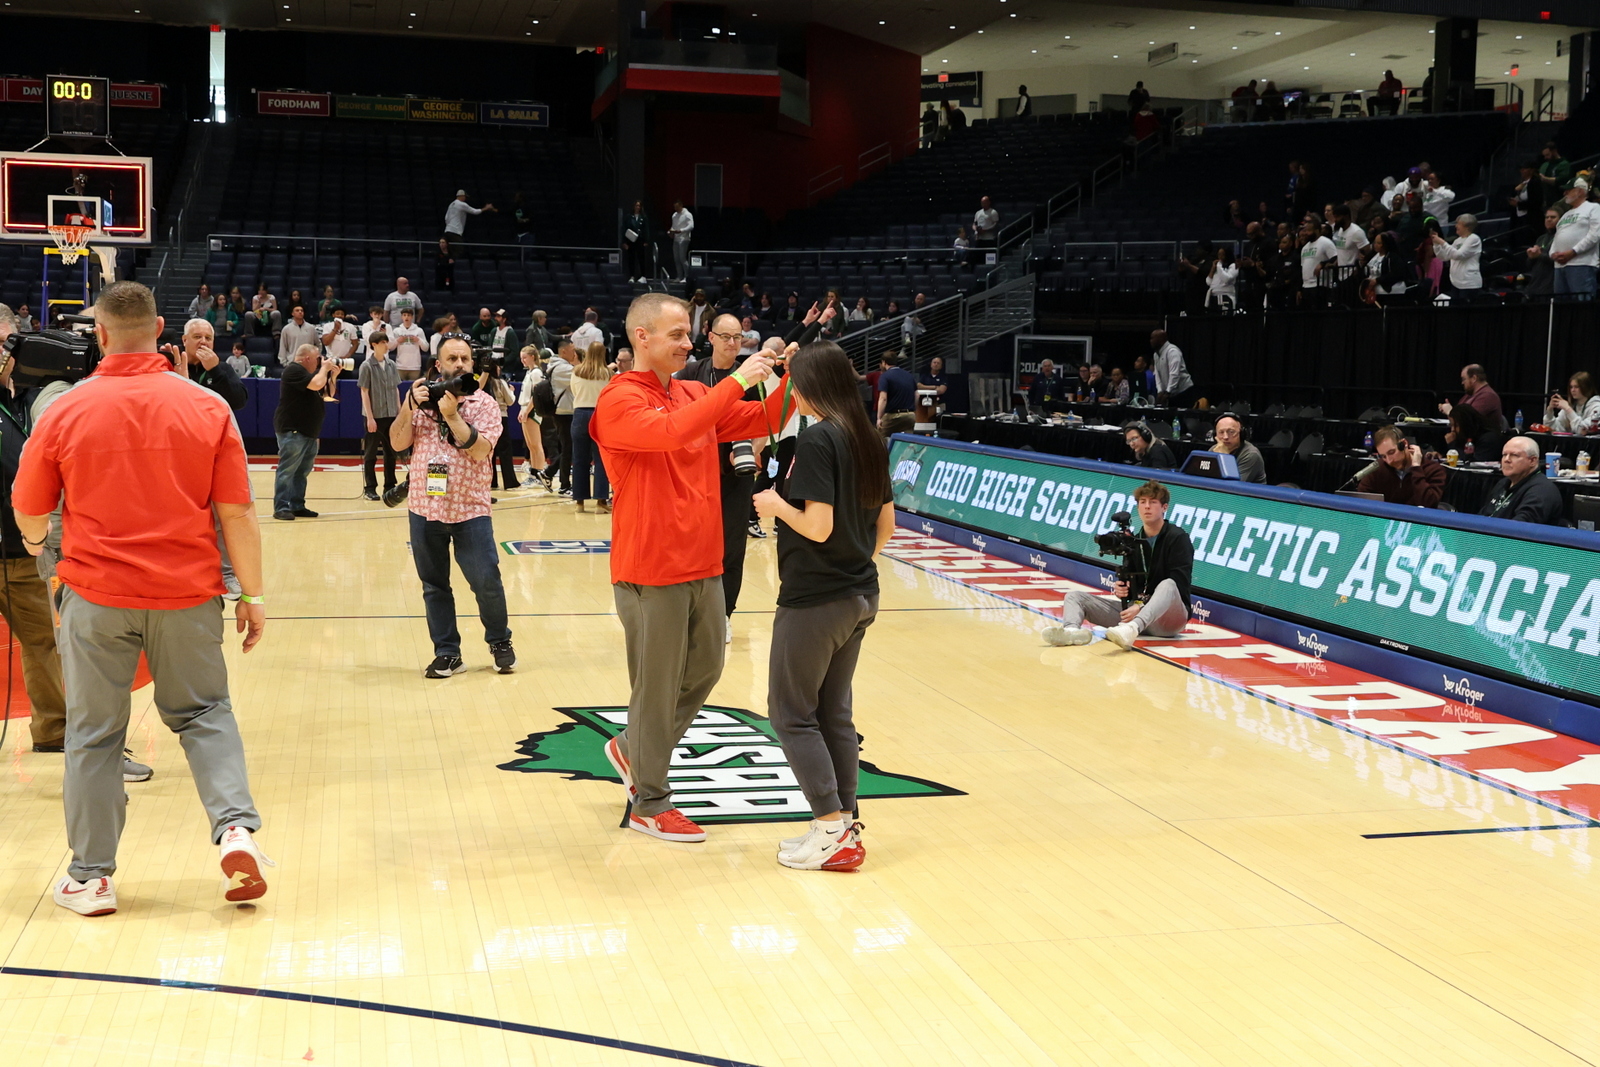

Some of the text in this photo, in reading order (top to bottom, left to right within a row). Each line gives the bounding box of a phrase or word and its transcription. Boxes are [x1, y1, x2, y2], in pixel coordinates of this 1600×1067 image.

[268, 98, 320, 110] FORDHAM
[338, 102, 406, 112] GEORGE MASON
[423, 102, 462, 112] GEORGE
[411, 110, 475, 121] WASHINGTON
[490, 109, 540, 121] LA SALLE
[926, 460, 978, 504] OHIO
[971, 469, 1037, 518] HIGH
[1163, 503, 1340, 589] THLETIC
[1193, 600, 1211, 622] Kroger
[1306, 633, 1329, 658] Kroger
[1379, 638, 1410, 651] DAKTRONICS
[1454, 678, 1485, 706] Kroger
